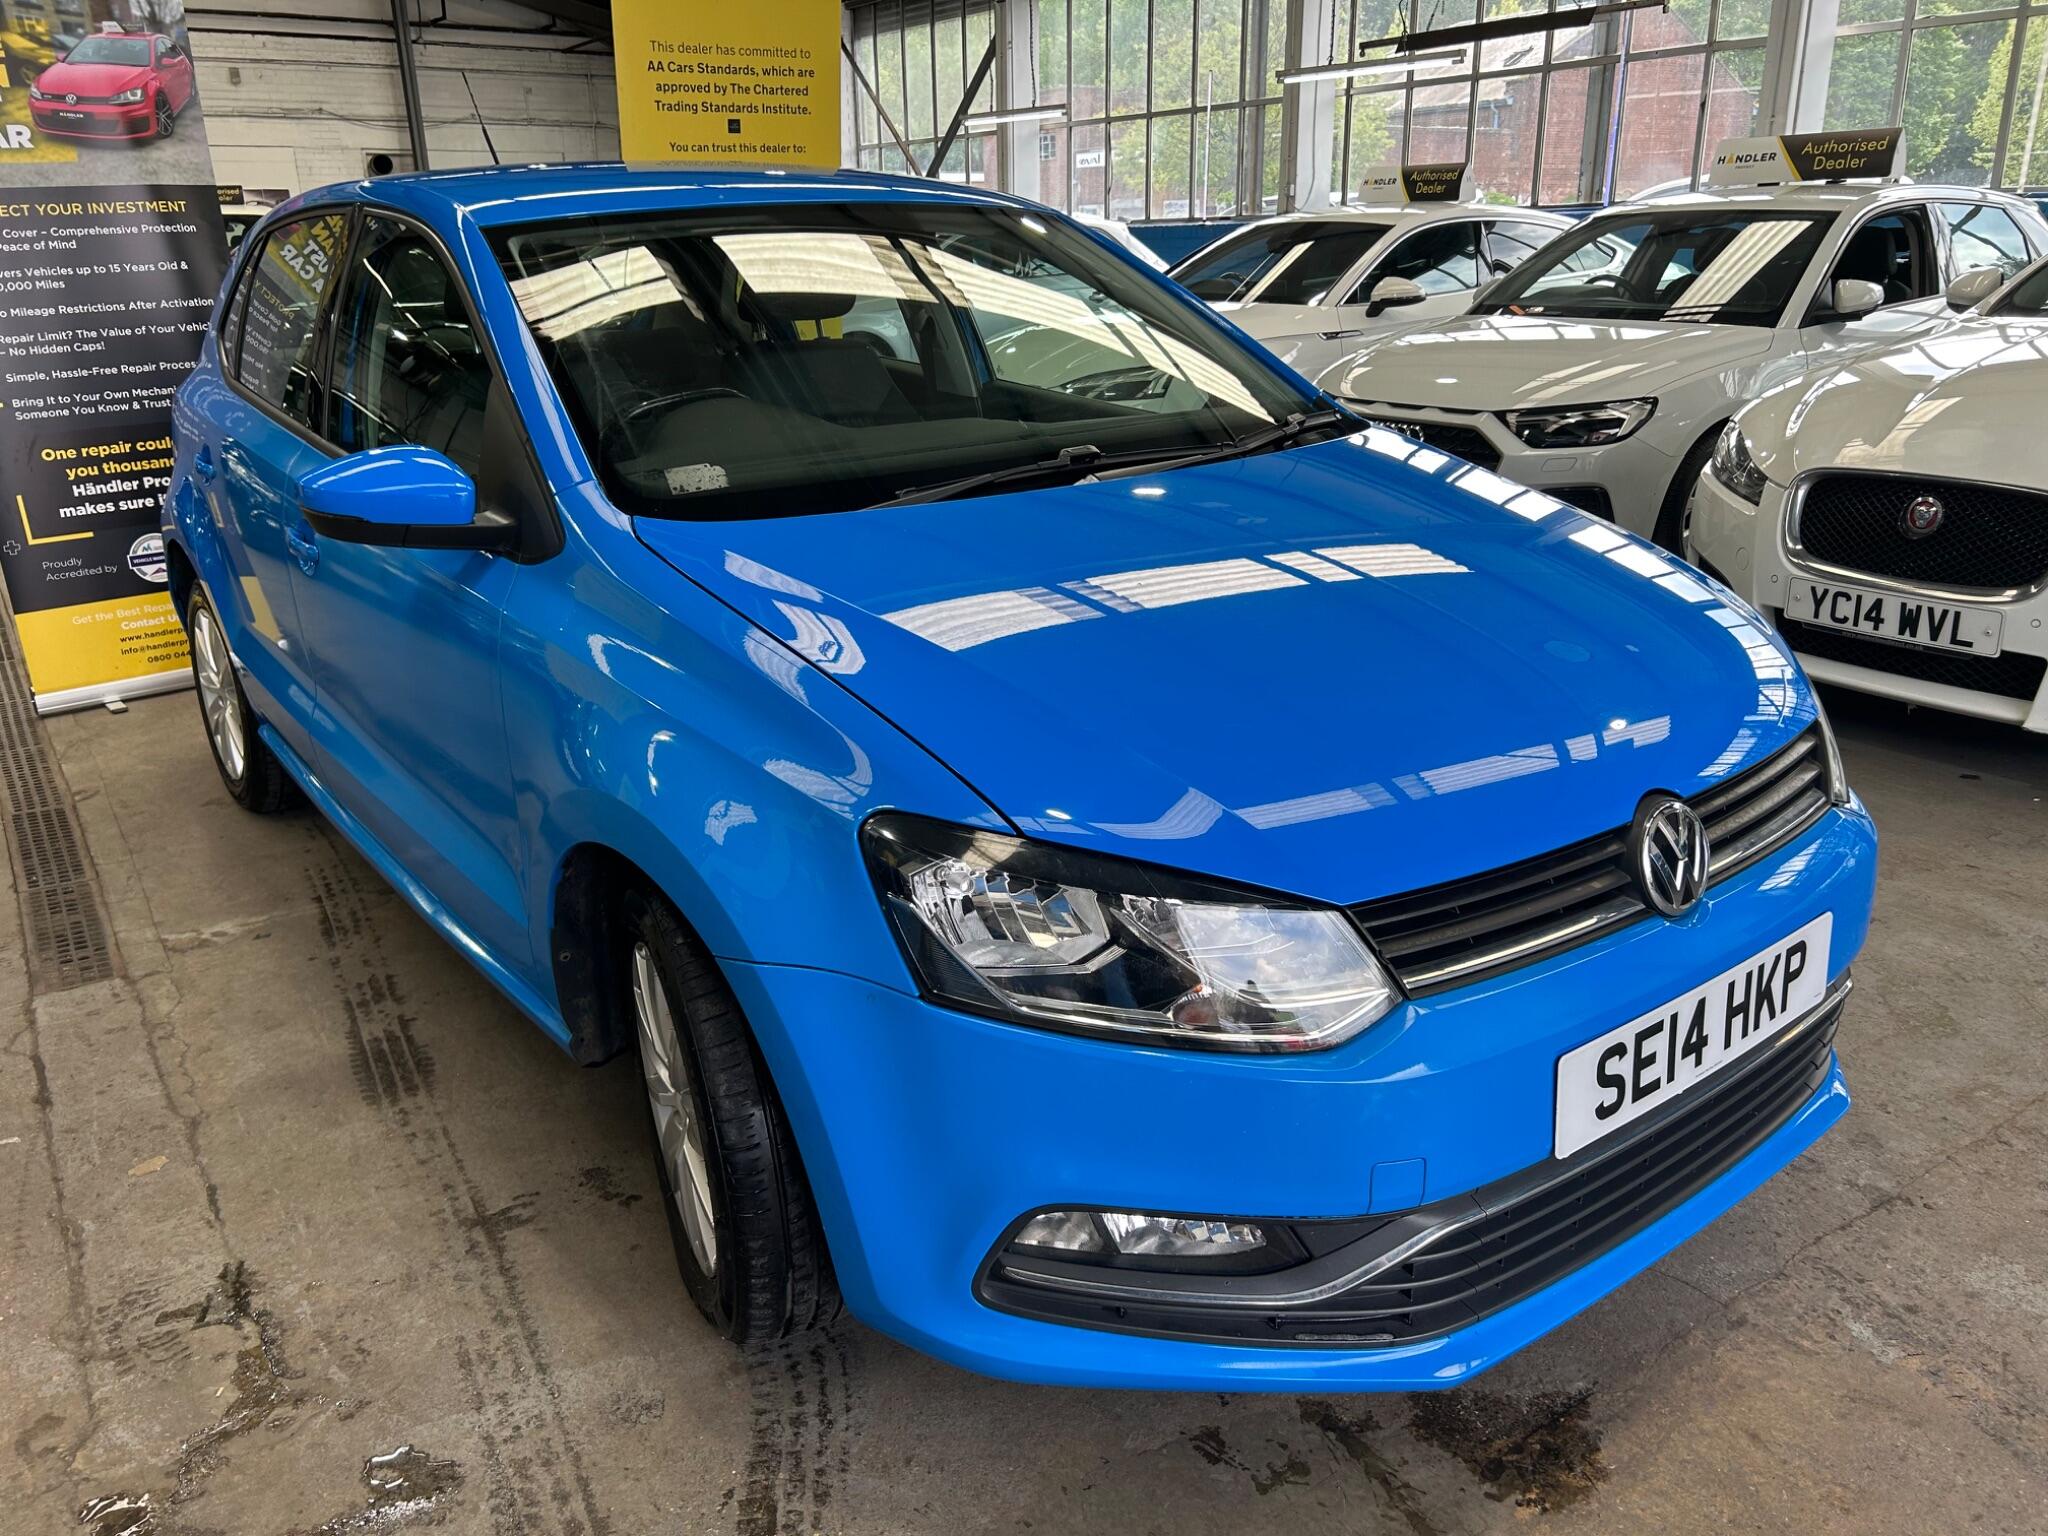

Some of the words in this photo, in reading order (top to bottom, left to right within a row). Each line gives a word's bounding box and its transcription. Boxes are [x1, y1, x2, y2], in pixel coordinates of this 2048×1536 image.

[650, 40, 674, 53] This
[677, 41, 713, 55] dealer
[715, 43, 736, 56] has
[738, 46, 797, 59] committed
[800, 48, 811, 59] to
[647, 60, 665, 72] AA
[667, 61, 694, 73] Cars
[697, 62, 759, 77] Standards,
[762, 65, 795, 77] which
[797, 68, 815, 78] are
[655, 81, 710, 94] approved
[713, 82, 727, 96] by
[729, 83, 751, 95] The
[753, 84, 809, 96] Chartered
[654, 99, 698, 115] Trading
[701, 101, 759, 114] Standards
[762, 103, 812, 115] Institute.
[669, 142, 689, 152] You
[691, 144, 709, 153] can
[712, 143, 737, 153] trust
[739, 143, 757, 153] this
[760, 143, 791, 153] dealer
[792, 144, 806, 154] to:
[1801, 134, 1890, 155] Authorised
[1813, 155, 1867, 171] Dealer
[1410, 169, 1460, 181] Authorised
[1415, 182, 1447, 194] Dealer
[34, 202, 83, 216] YOUR
[87, 201, 187, 215] INVESTMENT
[2, 228, 38, 239] Cover
[50, 225, 139, 238] Comprehensive
[140, 223, 197, 234] Protection
[33, 240, 45, 250] of
[48, 239, 77, 250] Mind
[24, 266, 74, 277] Vehicles
[76, 267, 92, 276] up
[93, 265, 106, 274] to
[108, 263, 120, 273] 15
[122, 262, 155, 272] Years
[158, 260, 178, 271] Old
[180, 260, 189, 270] &
[35, 279, 66, 290] Miles
[10, 307, 56, 317] Mileage
[58, 302, 126, 314] Restrictions
[128, 299, 157, 311] After
[160, 297, 215, 309] Activation
[37, 330, 73, 342] Limit?
[75, 328, 98, 339] The
[100, 326, 132, 337] Value
[134, 325, 146, 335] of
[148, 324, 176, 335] Your
[177, 322, 210, 333] Vehic
[9, 347, 26, 357] No
[29, 344, 71, 355] Hidden
[73, 341, 106, 352] Caps!
[5, 371, 50, 383] Simple,
[52, 366, 118, 379] Hassle-Free
[120, 362, 157, 374] Repair
[159, 360, 198, 371] Proces
[12, 397, 44, 408] Bring
[46, 396, 56, 405] It
[58, 395, 71, 404] to
[73, 393, 100, 403] Your
[103, 390, 130, 400] Own
[15, 407, 70, 421] Someone
[72, 405, 95, 416] You
[97, 402, 129, 413] Know
[132, 400, 141, 410] &
[142, 398, 172, 409] Trust
[41, 448, 77, 461] One
[81, 441, 131, 457] repair
[136, 436, 174, 451] coul
[65, 465, 99, 480] you
[72, 480, 139, 498] Händler
[143, 476, 171, 489] Pro
[59, 502, 116, 518] makes
[119, 497, 155, 511] sure
[42, 557, 82, 569] Proudly
[46, 566, 103, 581] Accredited
[104, 564, 118, 574] by
[72, 615, 93, 625] Get
[95, 612, 114, 621] the
[116, 608, 141, 618] Best
[120, 616, 165, 630] Contact
[1810, 585, 1885, 632] YC14
[1899, 602, 1974, 648] WVL
[147, 653, 172, 664] 0800
[1594, 996, 1708, 1121] SE14
[1723, 939, 1807, 1050] HKP
